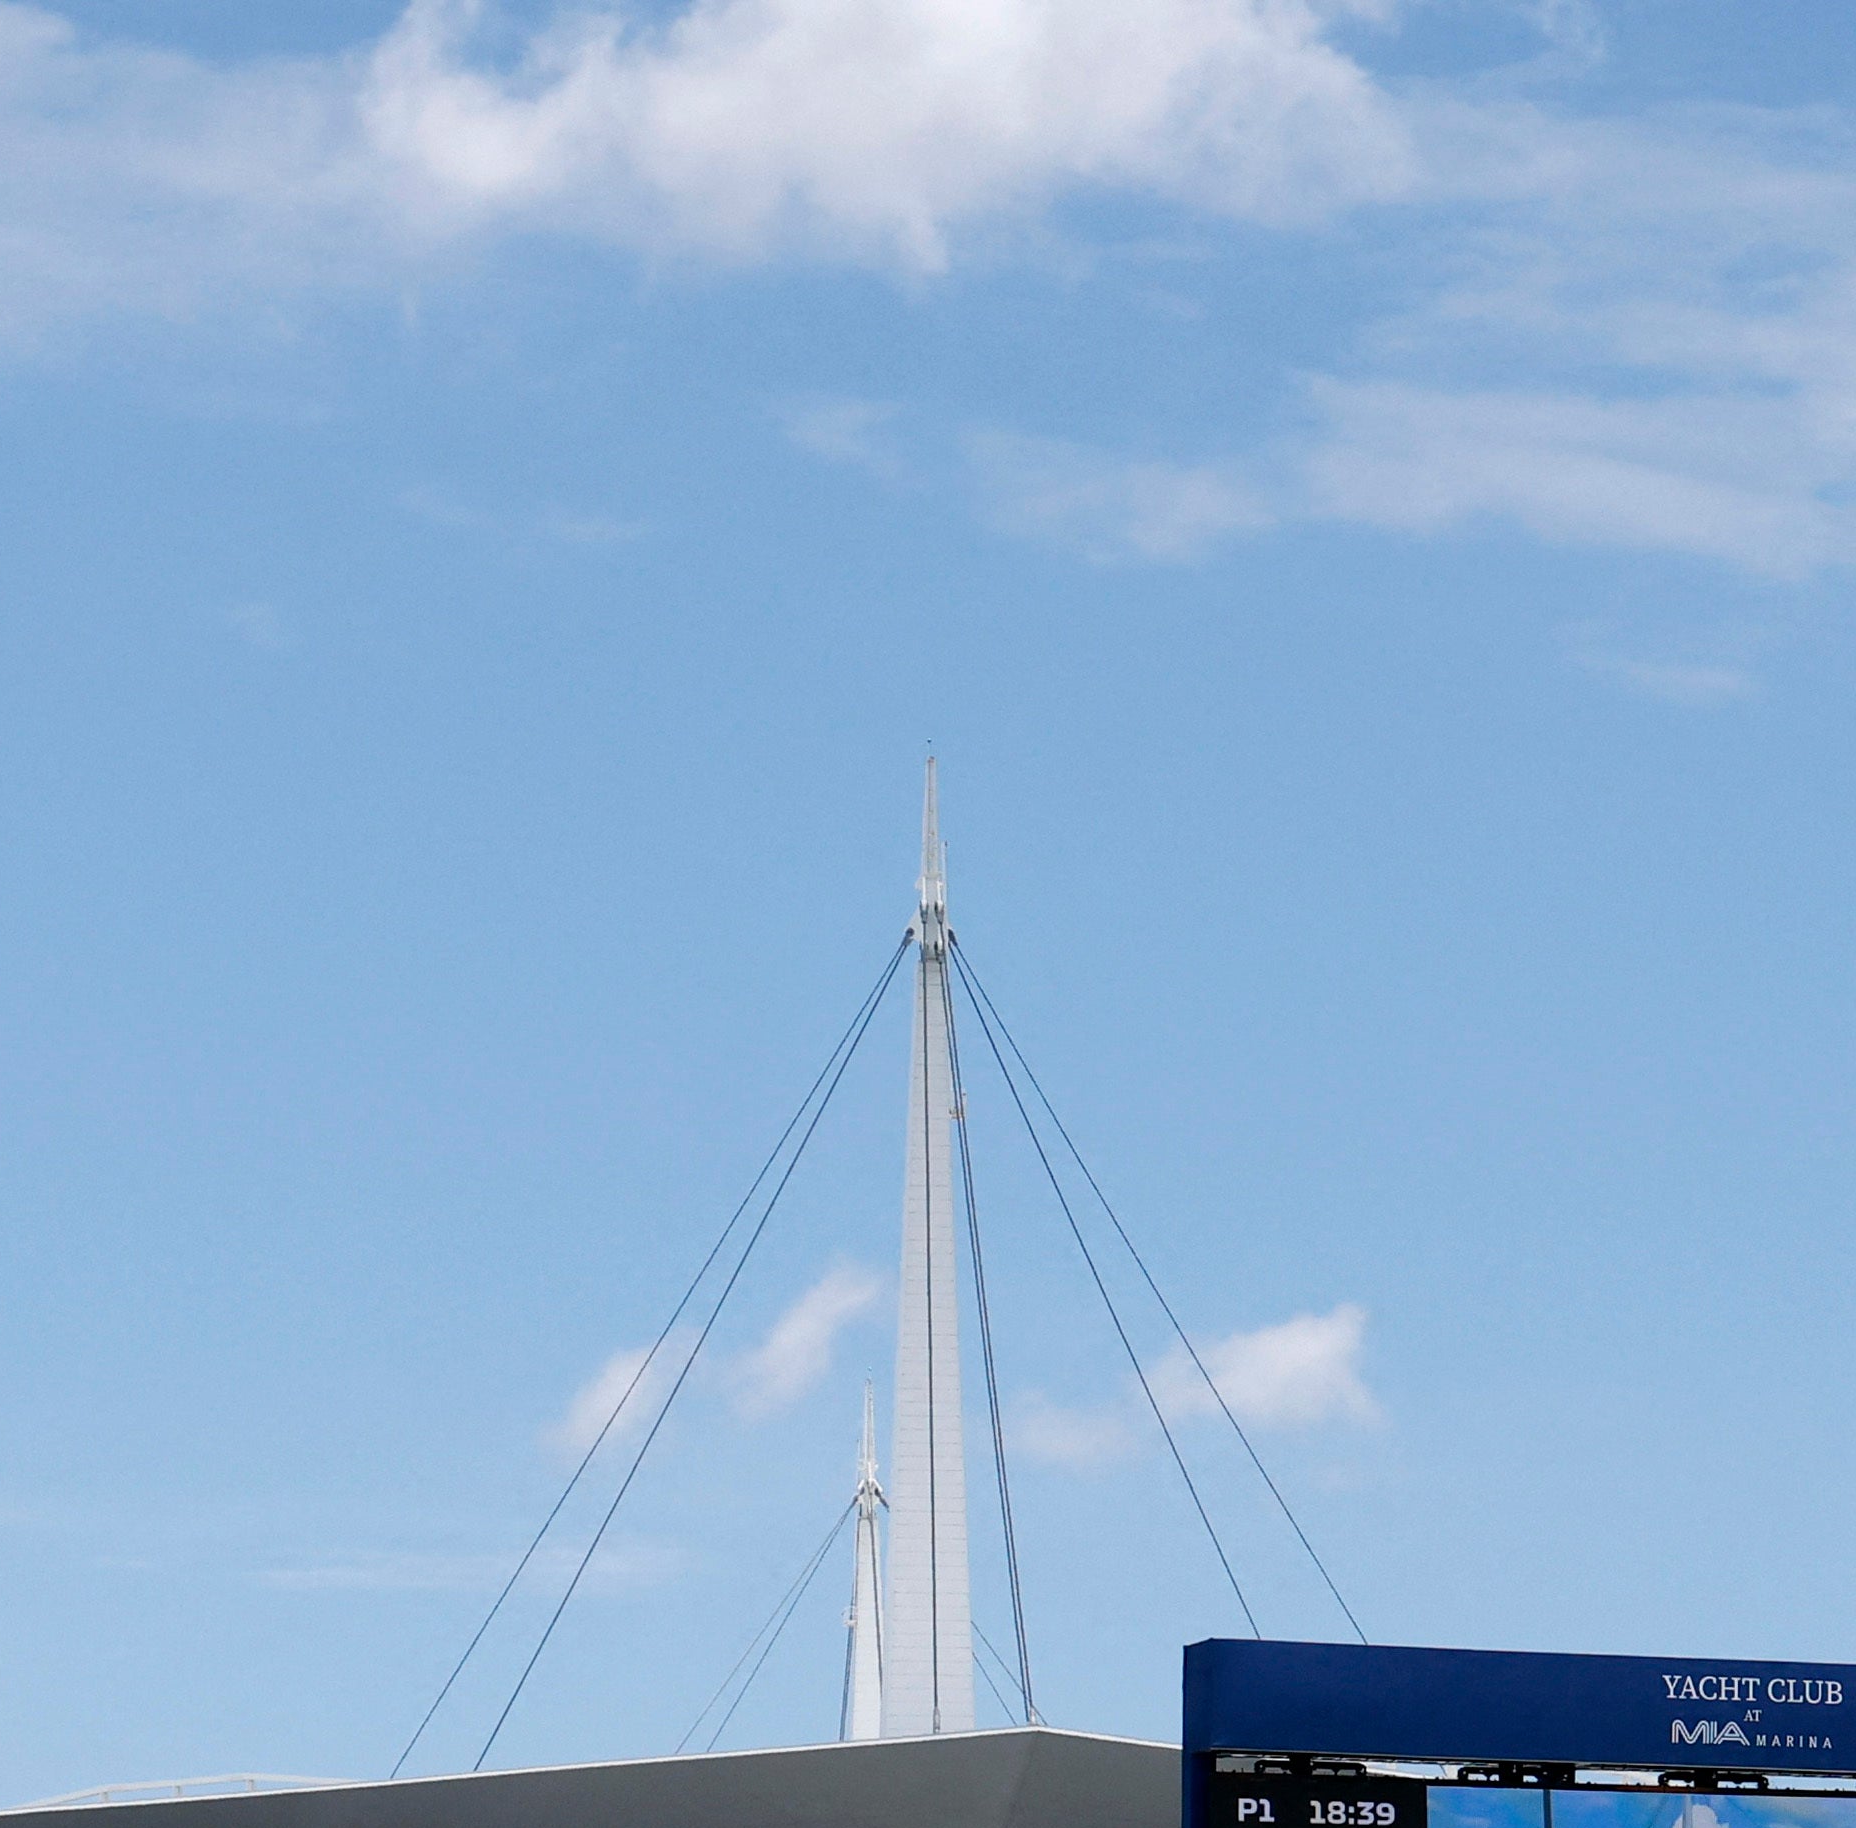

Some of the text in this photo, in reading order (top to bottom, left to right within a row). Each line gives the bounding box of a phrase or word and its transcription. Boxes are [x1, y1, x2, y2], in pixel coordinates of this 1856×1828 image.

[1662, 1675, 1843, 1705] YACHT CLUB
[1744, 1709, 1762, 1722] AT
[1671, 1719, 1832, 1749] MIA MARINA
[1237, 1798, 1395, 1825] P1 18:39
